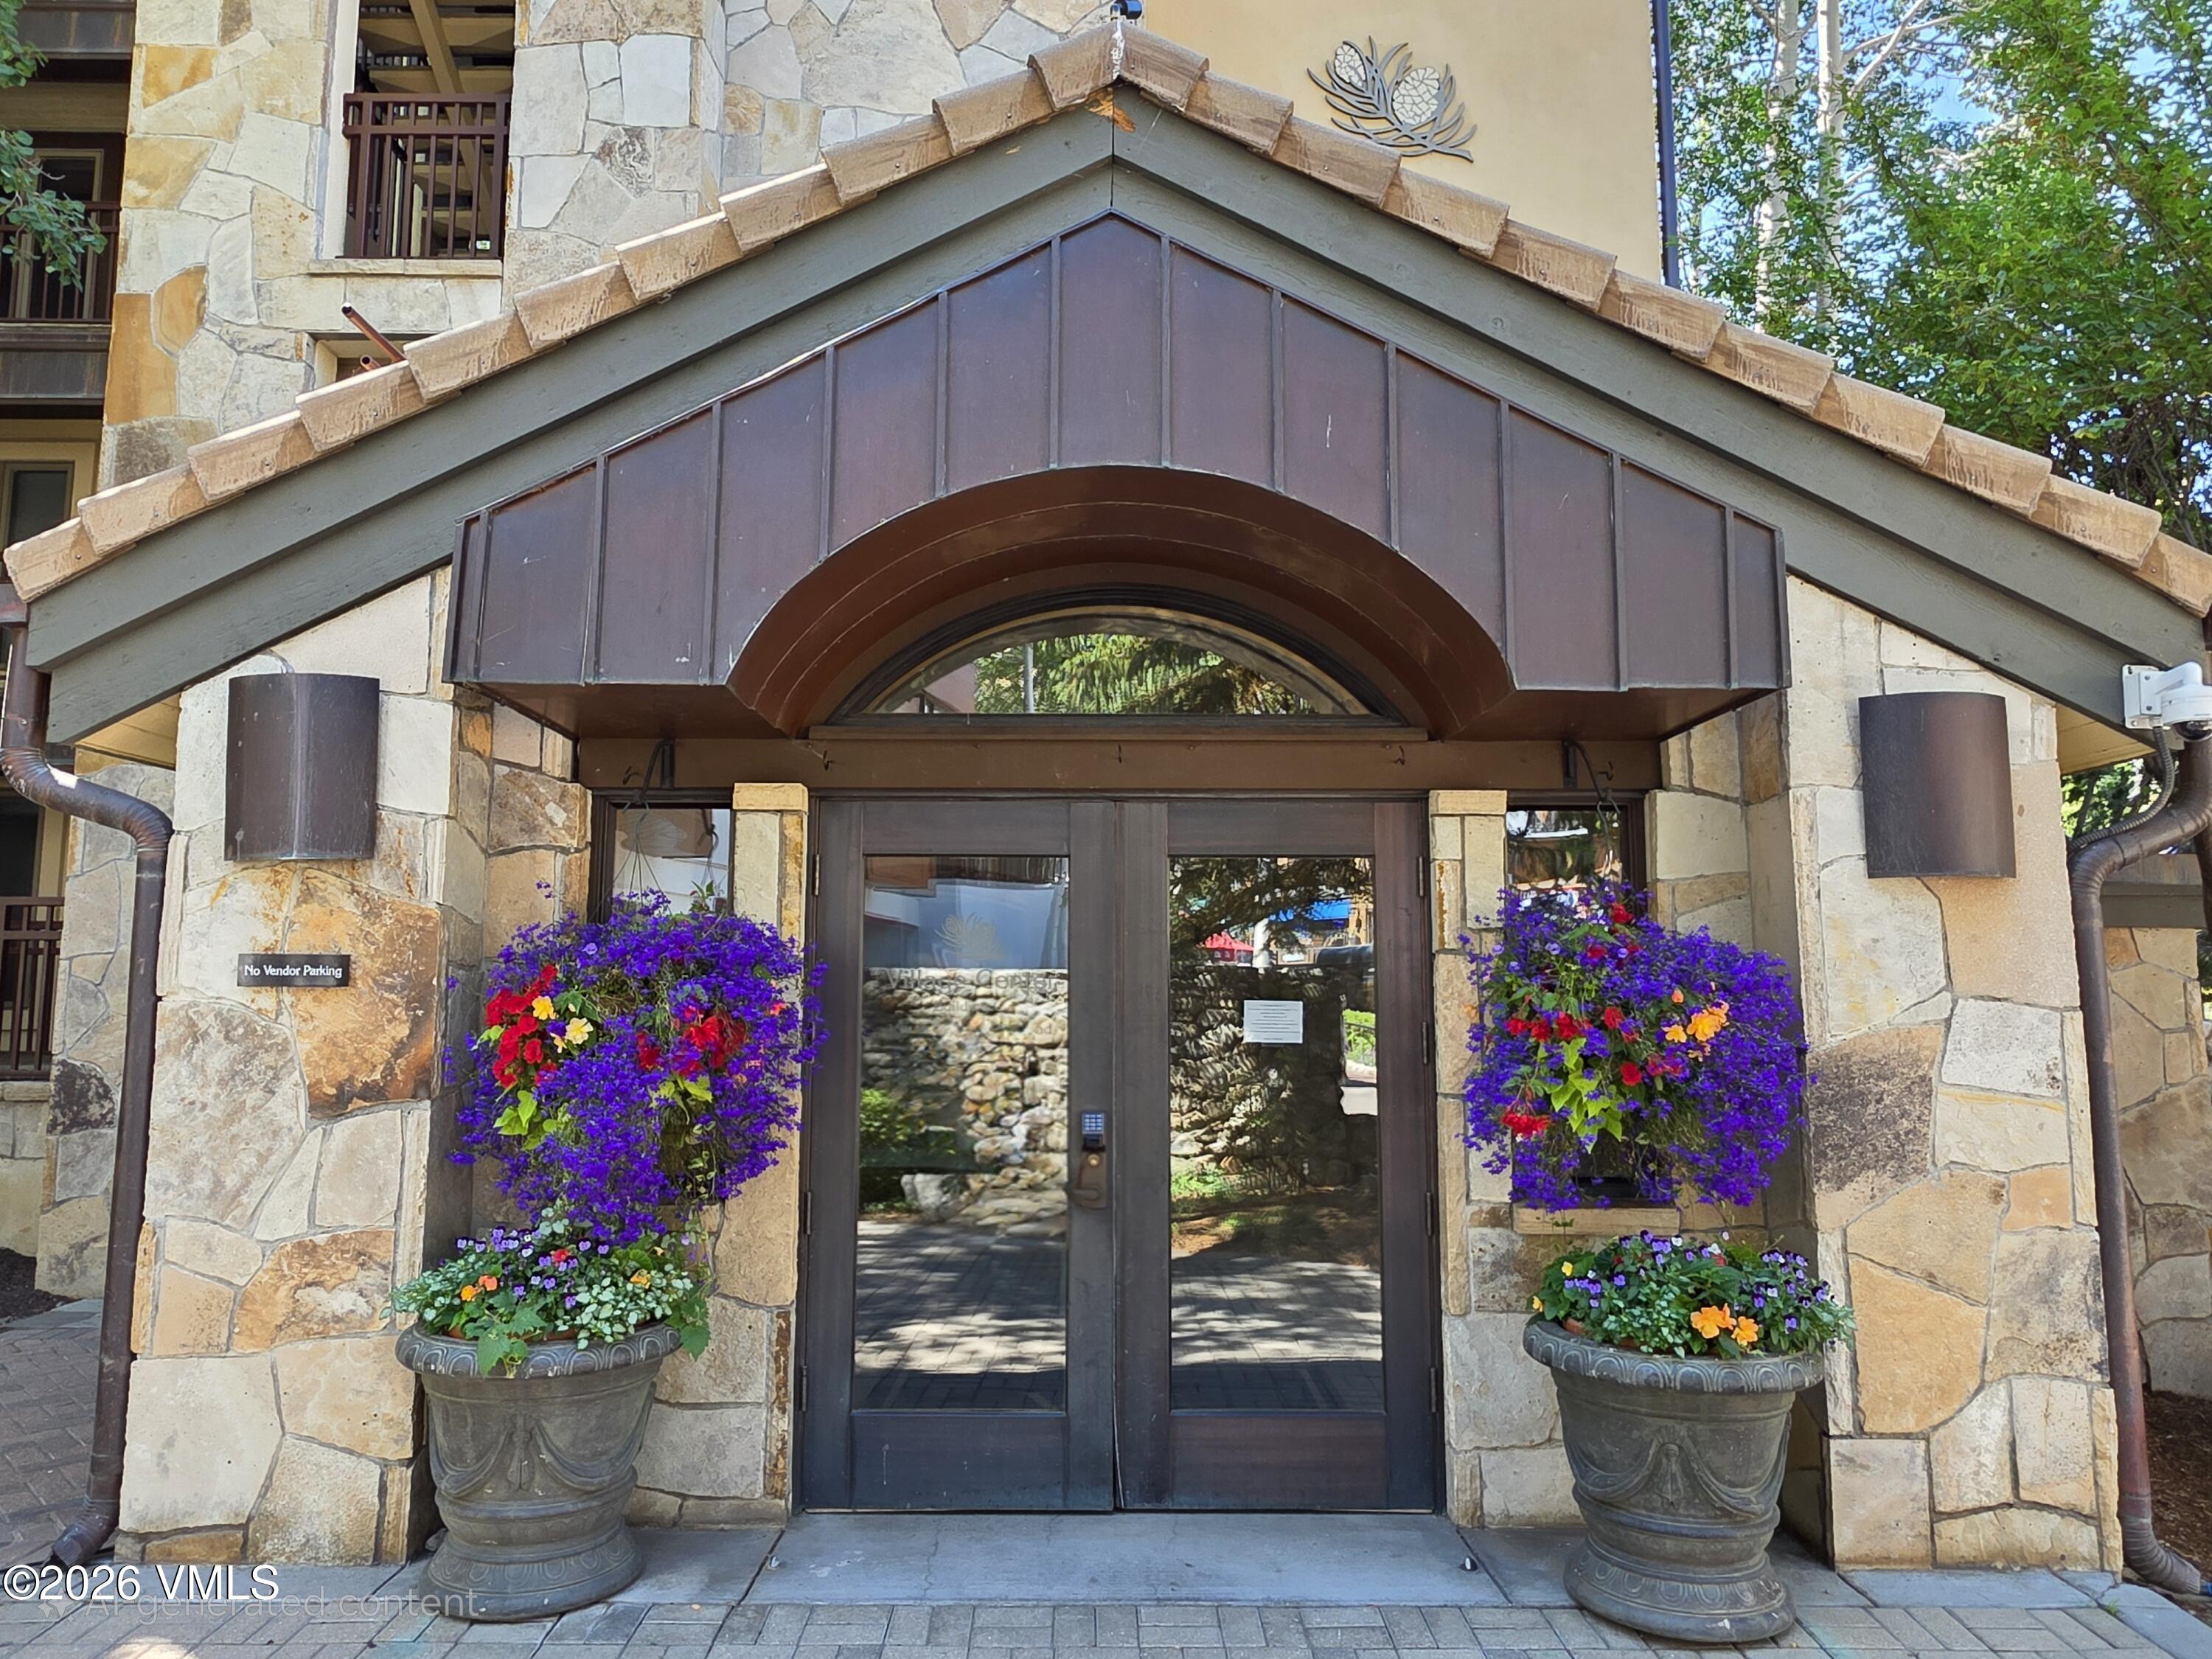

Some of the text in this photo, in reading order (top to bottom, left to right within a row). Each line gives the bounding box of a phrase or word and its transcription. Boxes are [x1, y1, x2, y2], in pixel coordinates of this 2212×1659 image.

[244, 964, 342, 978] No Vendor Parking
